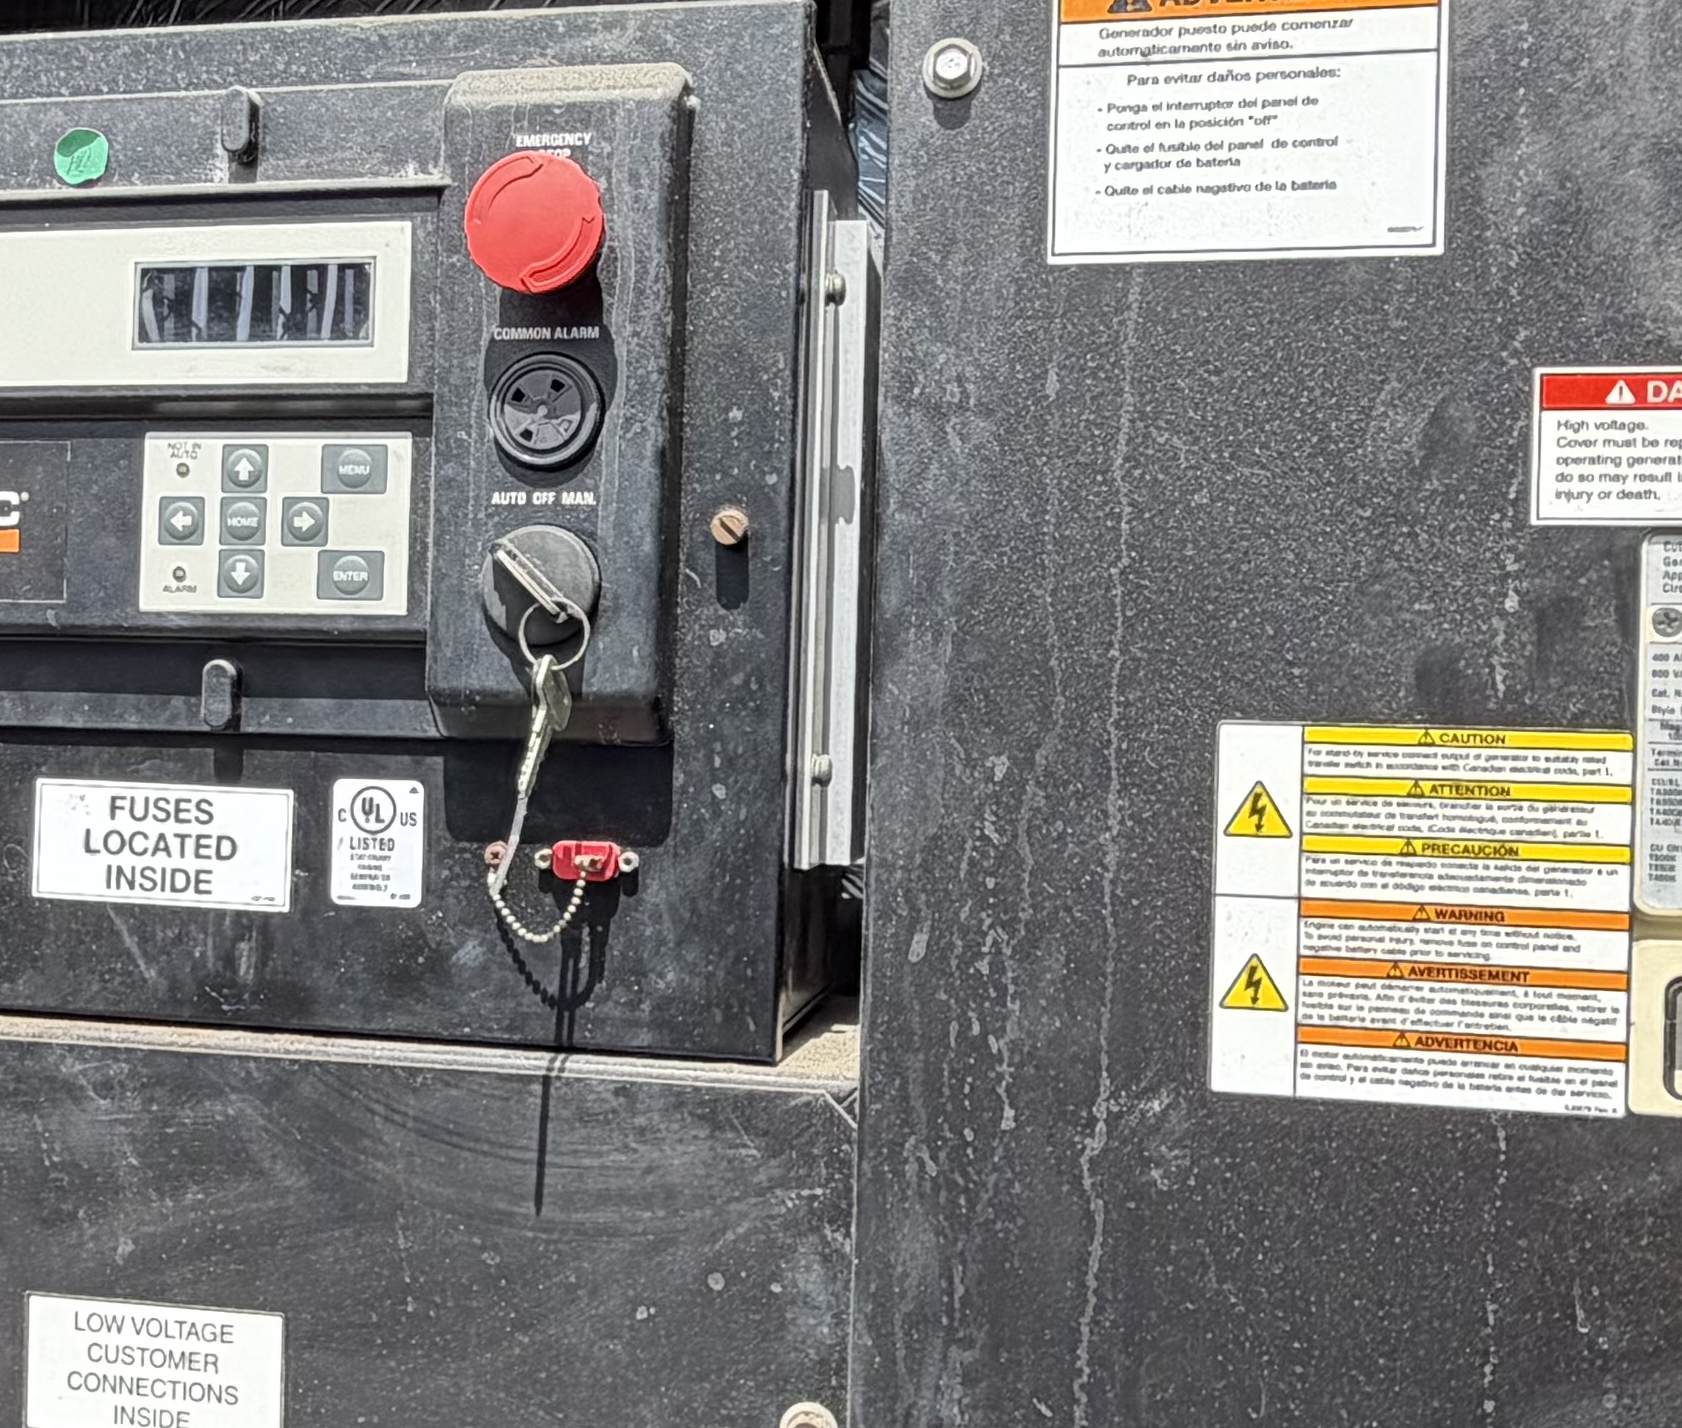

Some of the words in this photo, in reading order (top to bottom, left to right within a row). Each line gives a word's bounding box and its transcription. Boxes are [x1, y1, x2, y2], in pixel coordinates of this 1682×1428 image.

[1099, 27, 1173, 40] Generador
[1178, 23, 1227, 38] puesto
[1231, 21, 1276, 35] puede
[1281, 18, 1353, 32] comenzar
[516, 133, 591, 147] EMERGENCY
[494, 326, 551, 340] COMMON
[555, 326, 599, 340] ALARM
[1558, 420, 1589, 433] High
[1593, 420, 1648, 432] voltage.
[167, 442, 189, 451] NOT
[191, 442, 201, 450] IN
[1557, 437, 1599, 449] Cover
[1603, 438, 1637, 449] must
[1641, 436, 1659, 448] be
[170, 451, 197, 460] AUTO
[1556, 455, 1621, 468] operating
[339, 465, 370, 475] MENU
[1555, 471, 1573, 483] do
[1577, 473, 1595, 483] so
[1599, 473, 1628, 486] may
[1633, 471, 1672, 483] result
[492, 492, 527, 505] AUTO
[533, 492, 556, 505] OFF
[562, 492, 597, 506] MAN.
[1555, 488, 1593, 503] injury
[1597, 490, 1612, 500] or
[1616, 488, 1660, 501] death.
[227, 517, 258, 527] HOME
[333, 570, 368, 582] ENTER
[163, 585, 197, 594] ALARM
[1440, 733, 1506, 746] CAUTION
[1429, 784, 1511, 797] ATTENTION
[110, 795, 214, 825] FUSES
[337, 808, 347, 823] C
[361, 797, 385, 825] UL
[399, 812, 417, 827] US
[83, 828, 237, 861] LOCATED
[349, 836, 395, 853] LISTED
[1421, 842, 1520, 857] PRECAUCIÓN
[105, 864, 213, 895] INSIDE
[1435, 909, 1505, 923] WARNING
[1408, 966, 1530, 983] AVERTISSEMENT
[1414, 1036, 1518, 1052] ADVERTENCIA
[75, 1310, 125, 1334] LOW
[131, 1316, 234, 1344] VOLTAGE
[87, 1342, 219, 1374] CUSTOMER
[67, 1370, 239, 1406] CONNECTIONS
